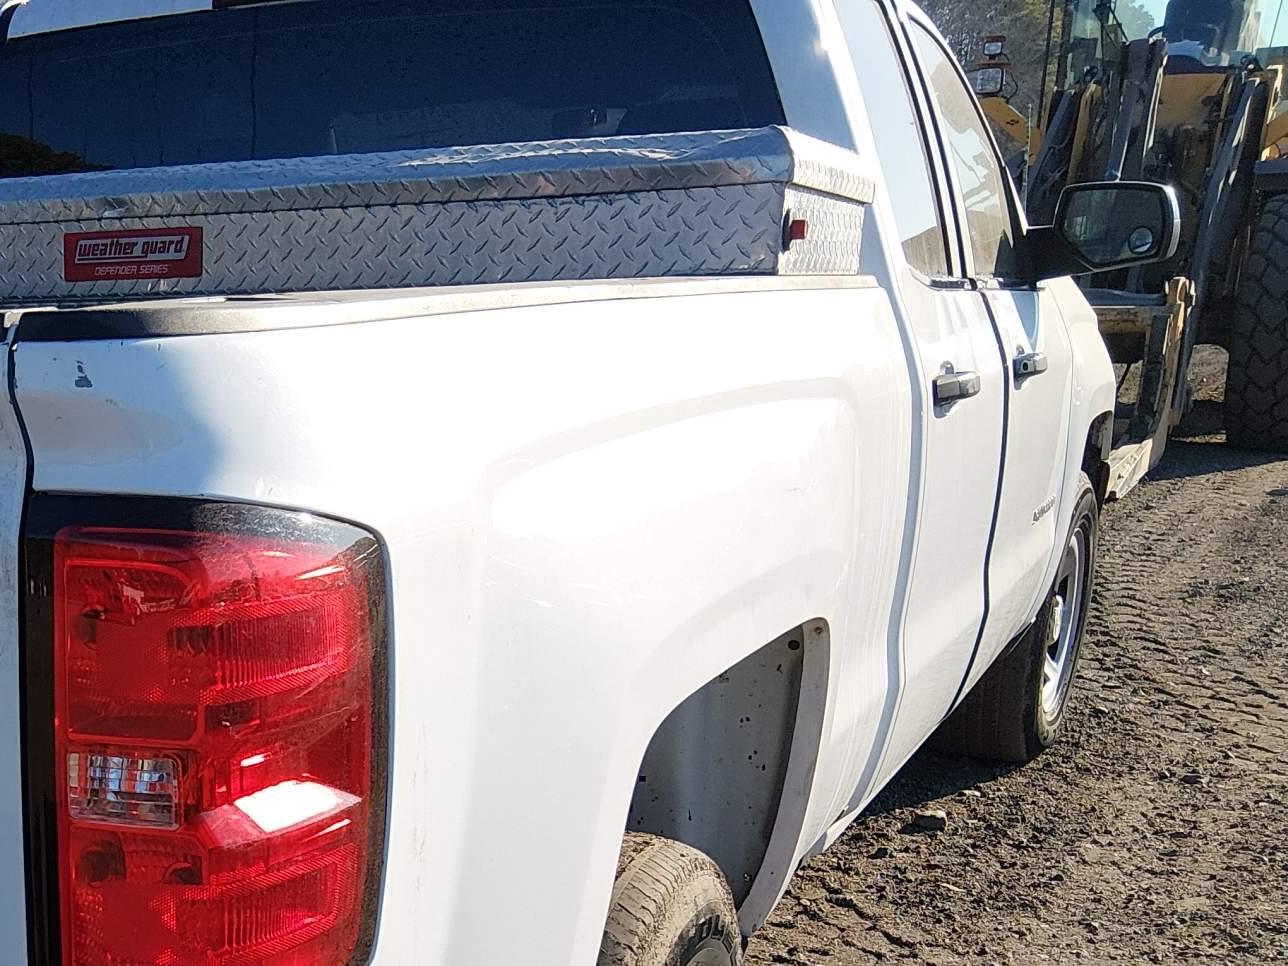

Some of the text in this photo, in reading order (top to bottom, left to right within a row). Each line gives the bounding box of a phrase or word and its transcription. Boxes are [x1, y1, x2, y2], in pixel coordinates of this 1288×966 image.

[77, 236, 185, 258] weather guard
[94, 264, 169, 275] DEFENDER SERIES
